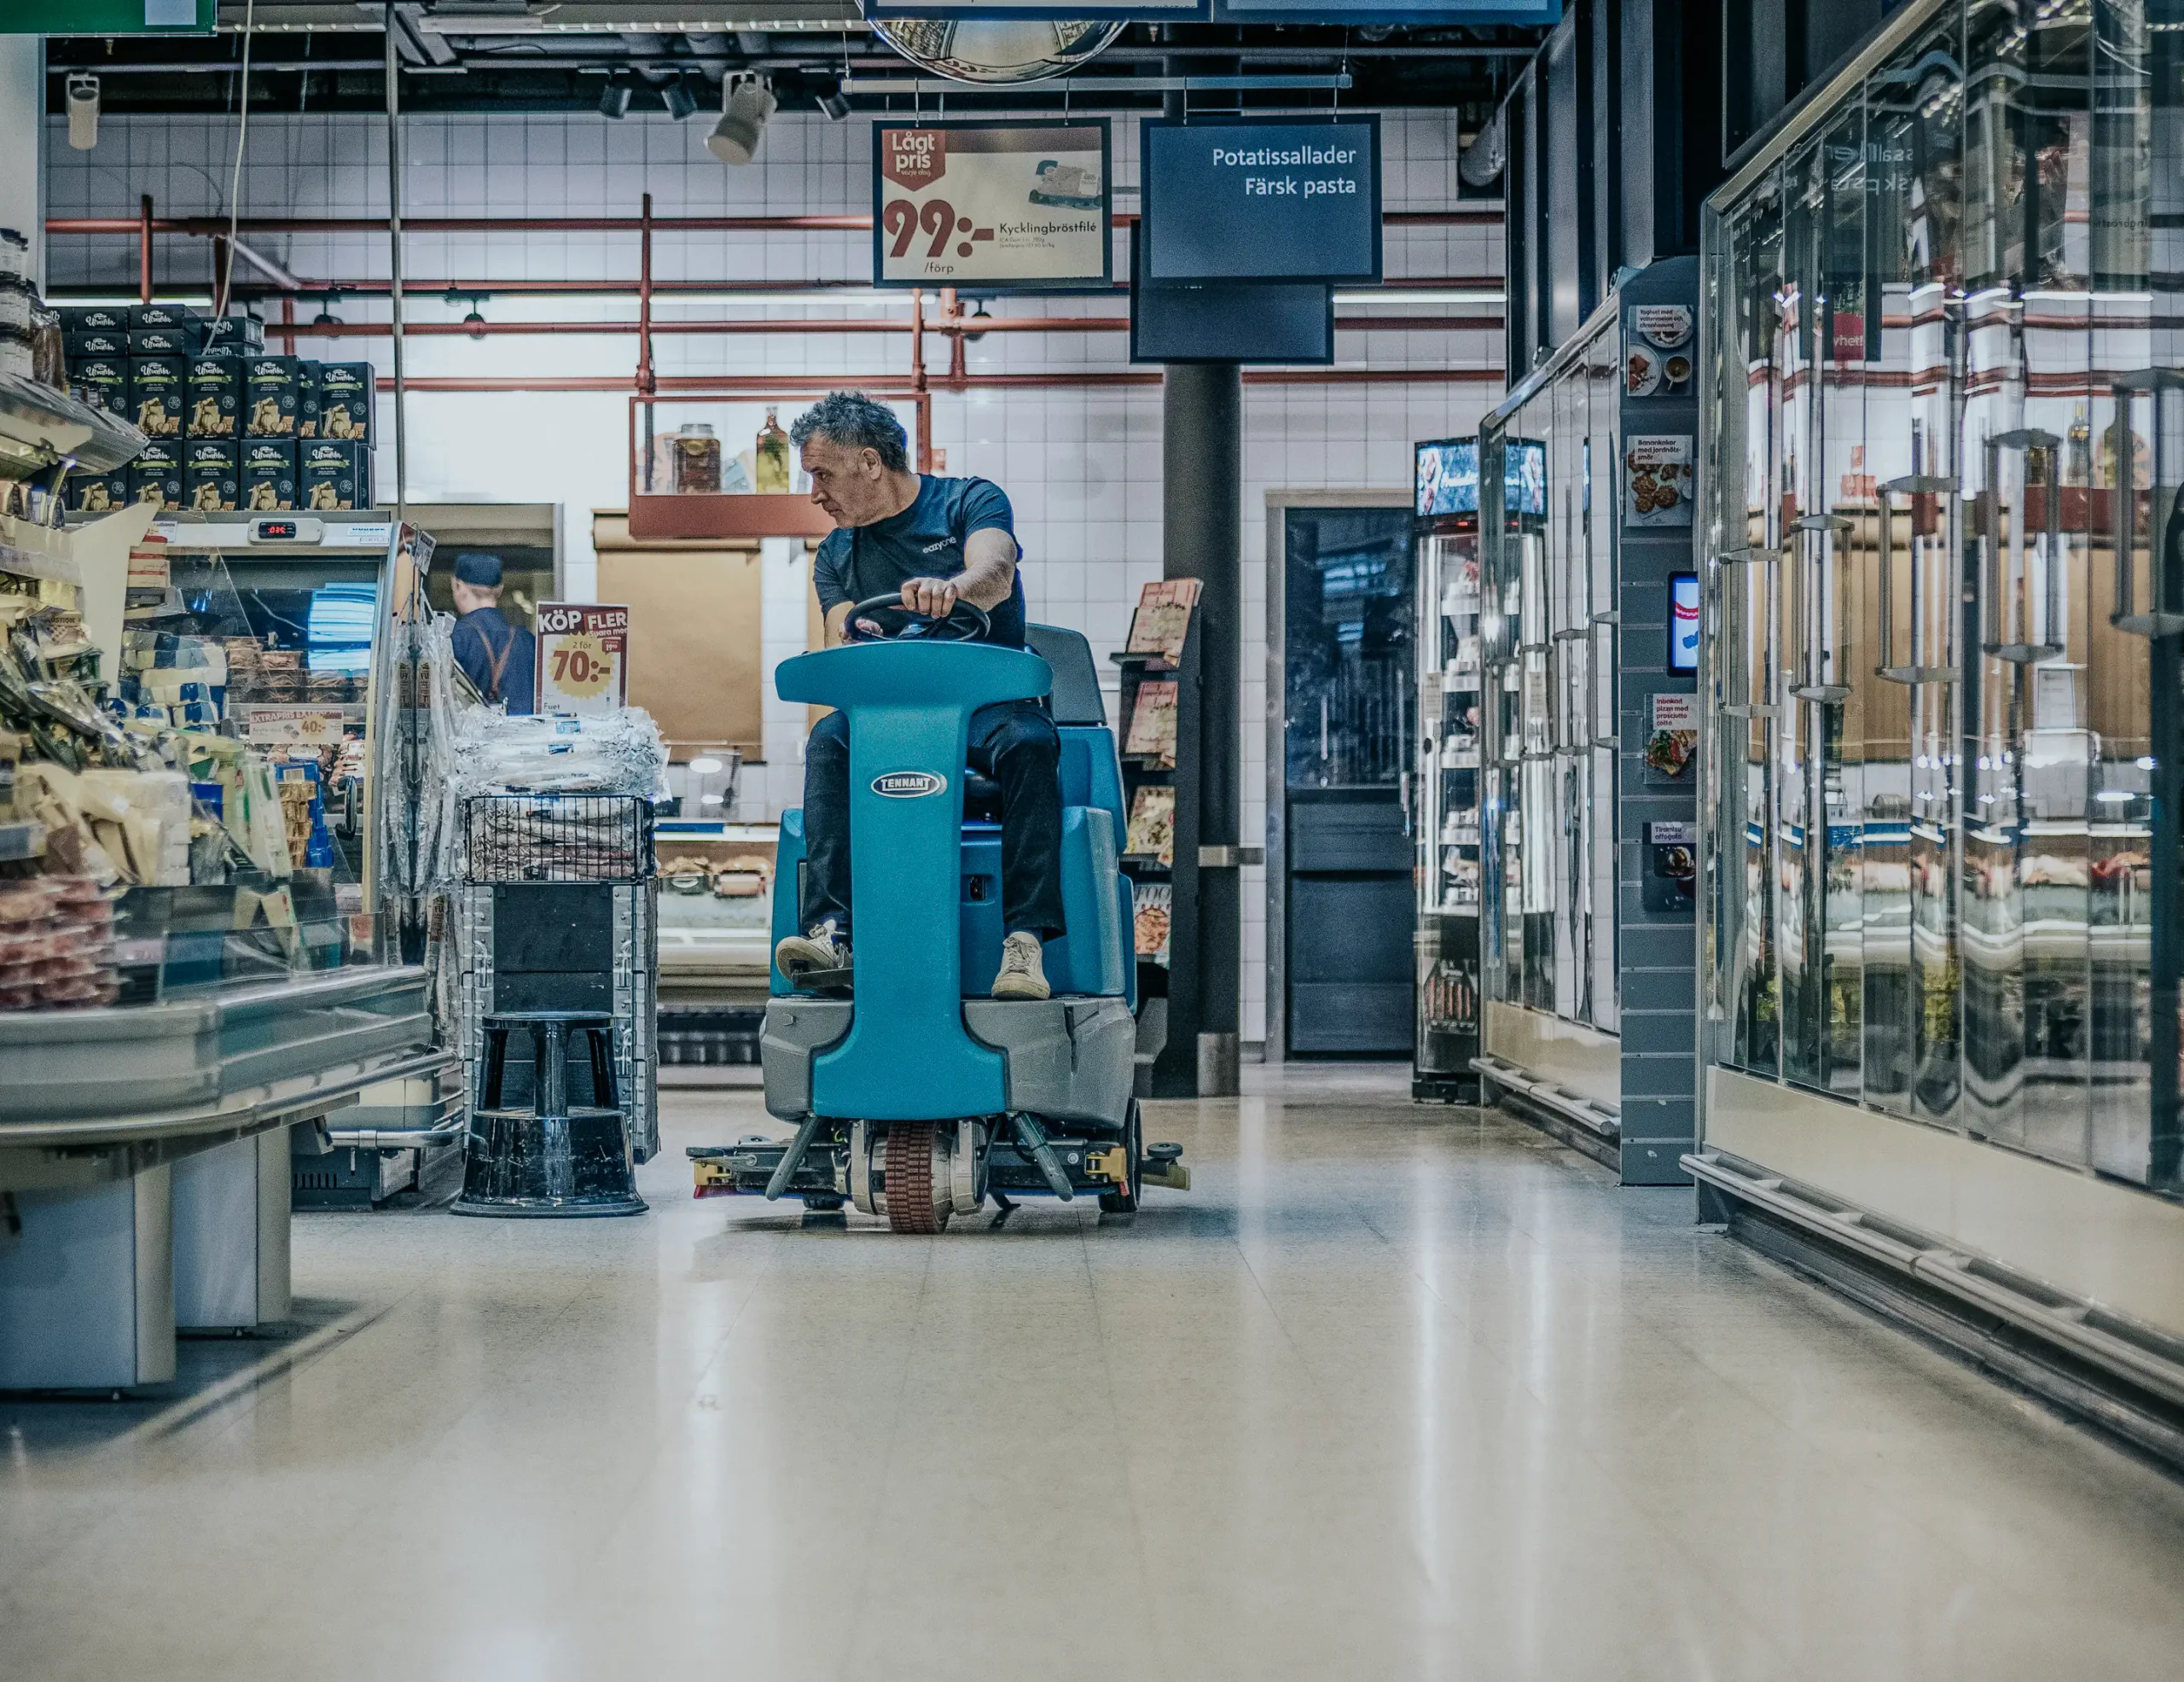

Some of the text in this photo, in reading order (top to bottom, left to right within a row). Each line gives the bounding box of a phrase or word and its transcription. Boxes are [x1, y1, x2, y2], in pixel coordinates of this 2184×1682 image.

[892, 131, 935, 153] Lågt
[896, 153, 932, 172] pris
[1212, 145, 1357, 166] Potatissallader
[1245, 176, 1357, 200] Färsk pasta
[883, 199, 994, 258] 99:-
[999, 220, 1097, 236] Kycklingbröstfilé
[924, 261, 955, 274] /förp
[537, 609, 627, 633] KÖP FLER
[579, 641, 592, 649] för
[553, 650, 611, 683] 70:-
[301, 720, 326, 733] 40:-
[880, 777, 932, 791] TENNANT
